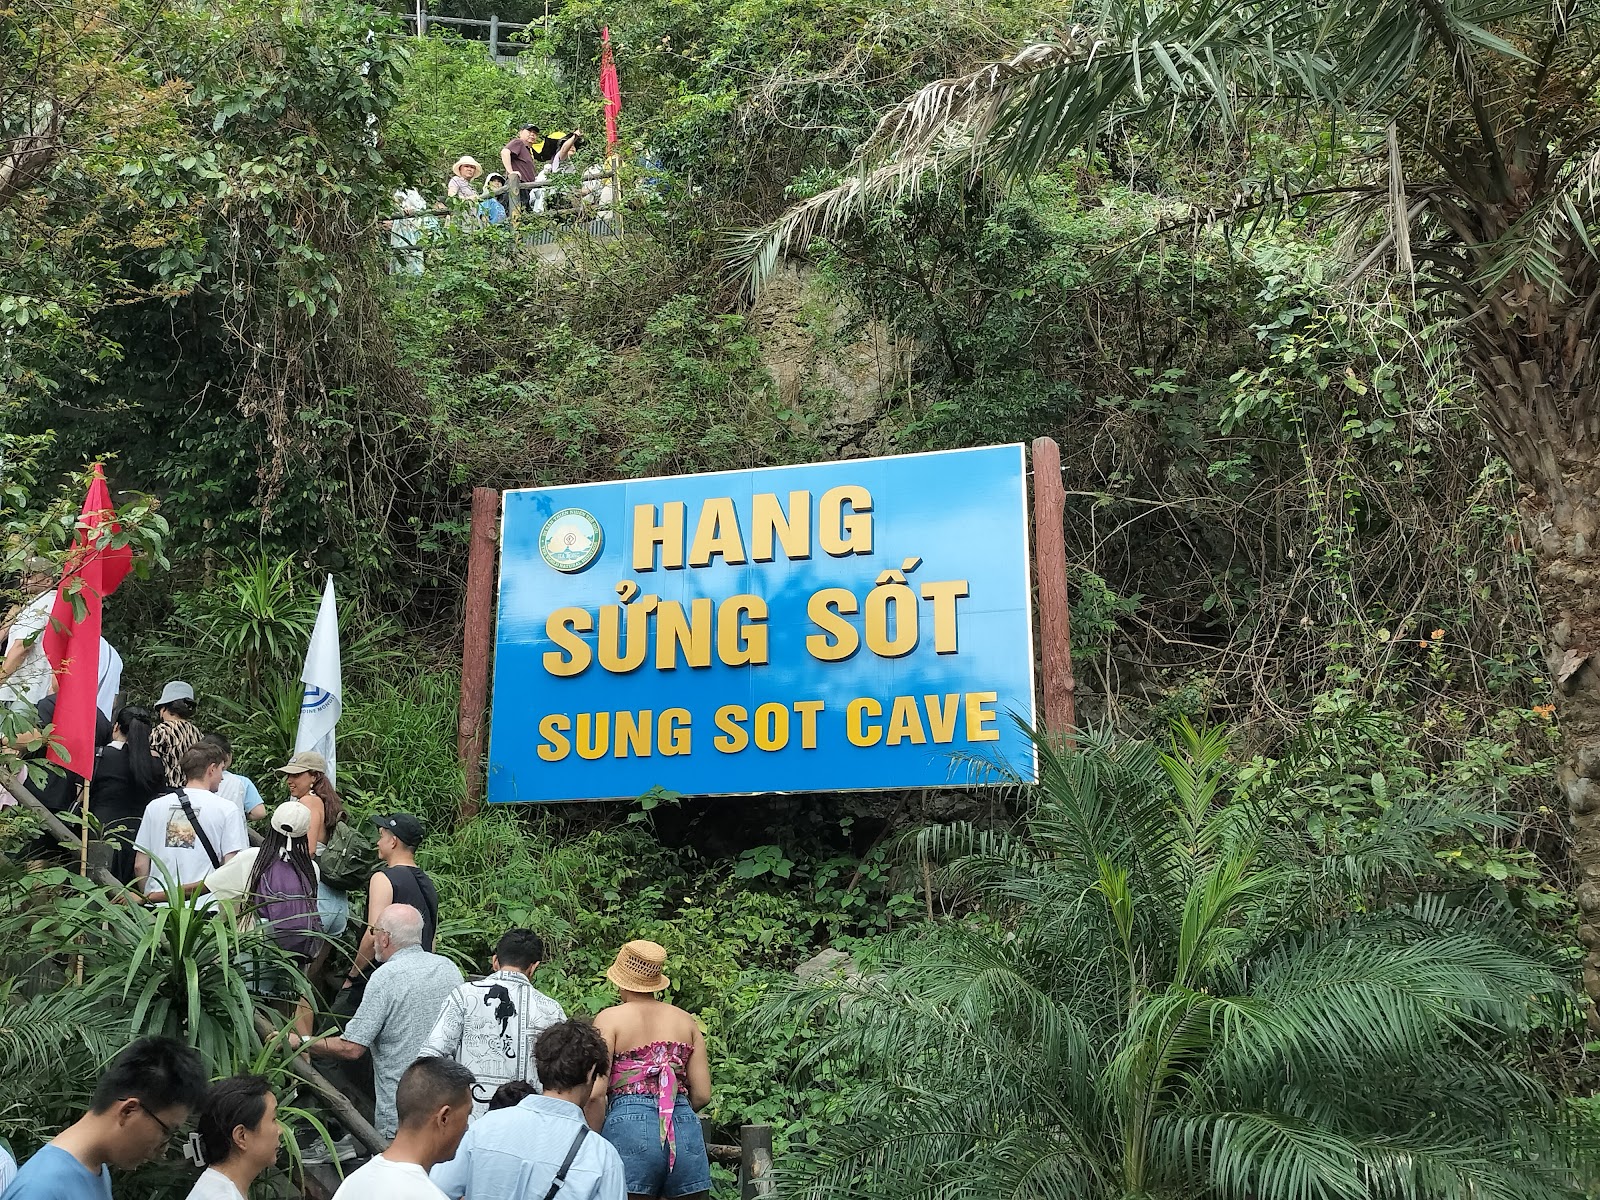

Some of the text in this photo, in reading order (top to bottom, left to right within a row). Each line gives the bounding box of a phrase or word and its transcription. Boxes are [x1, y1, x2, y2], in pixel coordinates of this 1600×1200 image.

[633, 486, 873, 571] HANG
[542, 557, 969, 677] SỬNG SỐT
[537, 692, 999, 761] SUNG SOT CAVE
